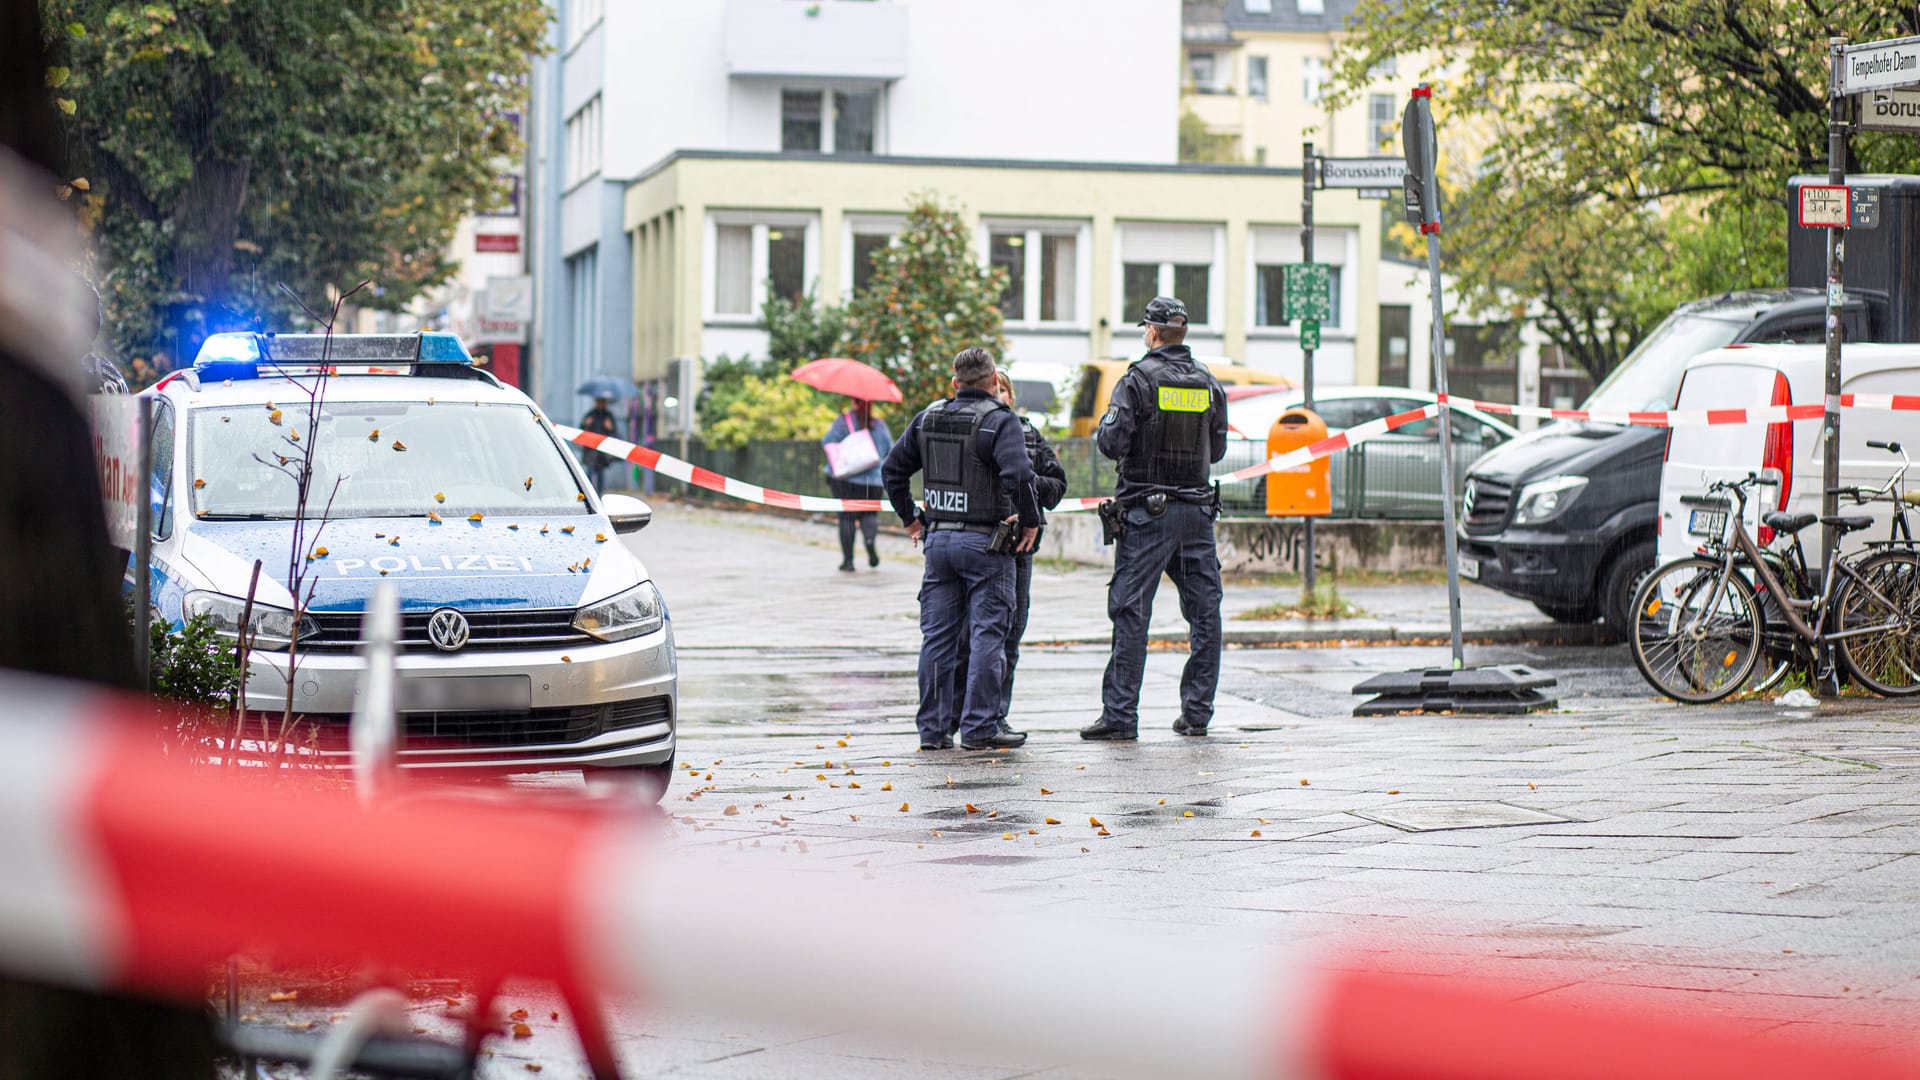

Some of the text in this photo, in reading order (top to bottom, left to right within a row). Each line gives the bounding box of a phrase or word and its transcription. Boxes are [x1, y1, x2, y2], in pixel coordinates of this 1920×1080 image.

[1851, 50, 1917, 79] Tempelhofer Damm
[1325, 163, 1408, 179] Borussiastra
[1852, 191, 1859, 201] S
[1162, 390, 1207, 409] POLIZEI
[924, 488, 968, 513] POLIZEI
[335, 554, 534, 576] POLIZEI
[430, 609, 470, 650] VW
